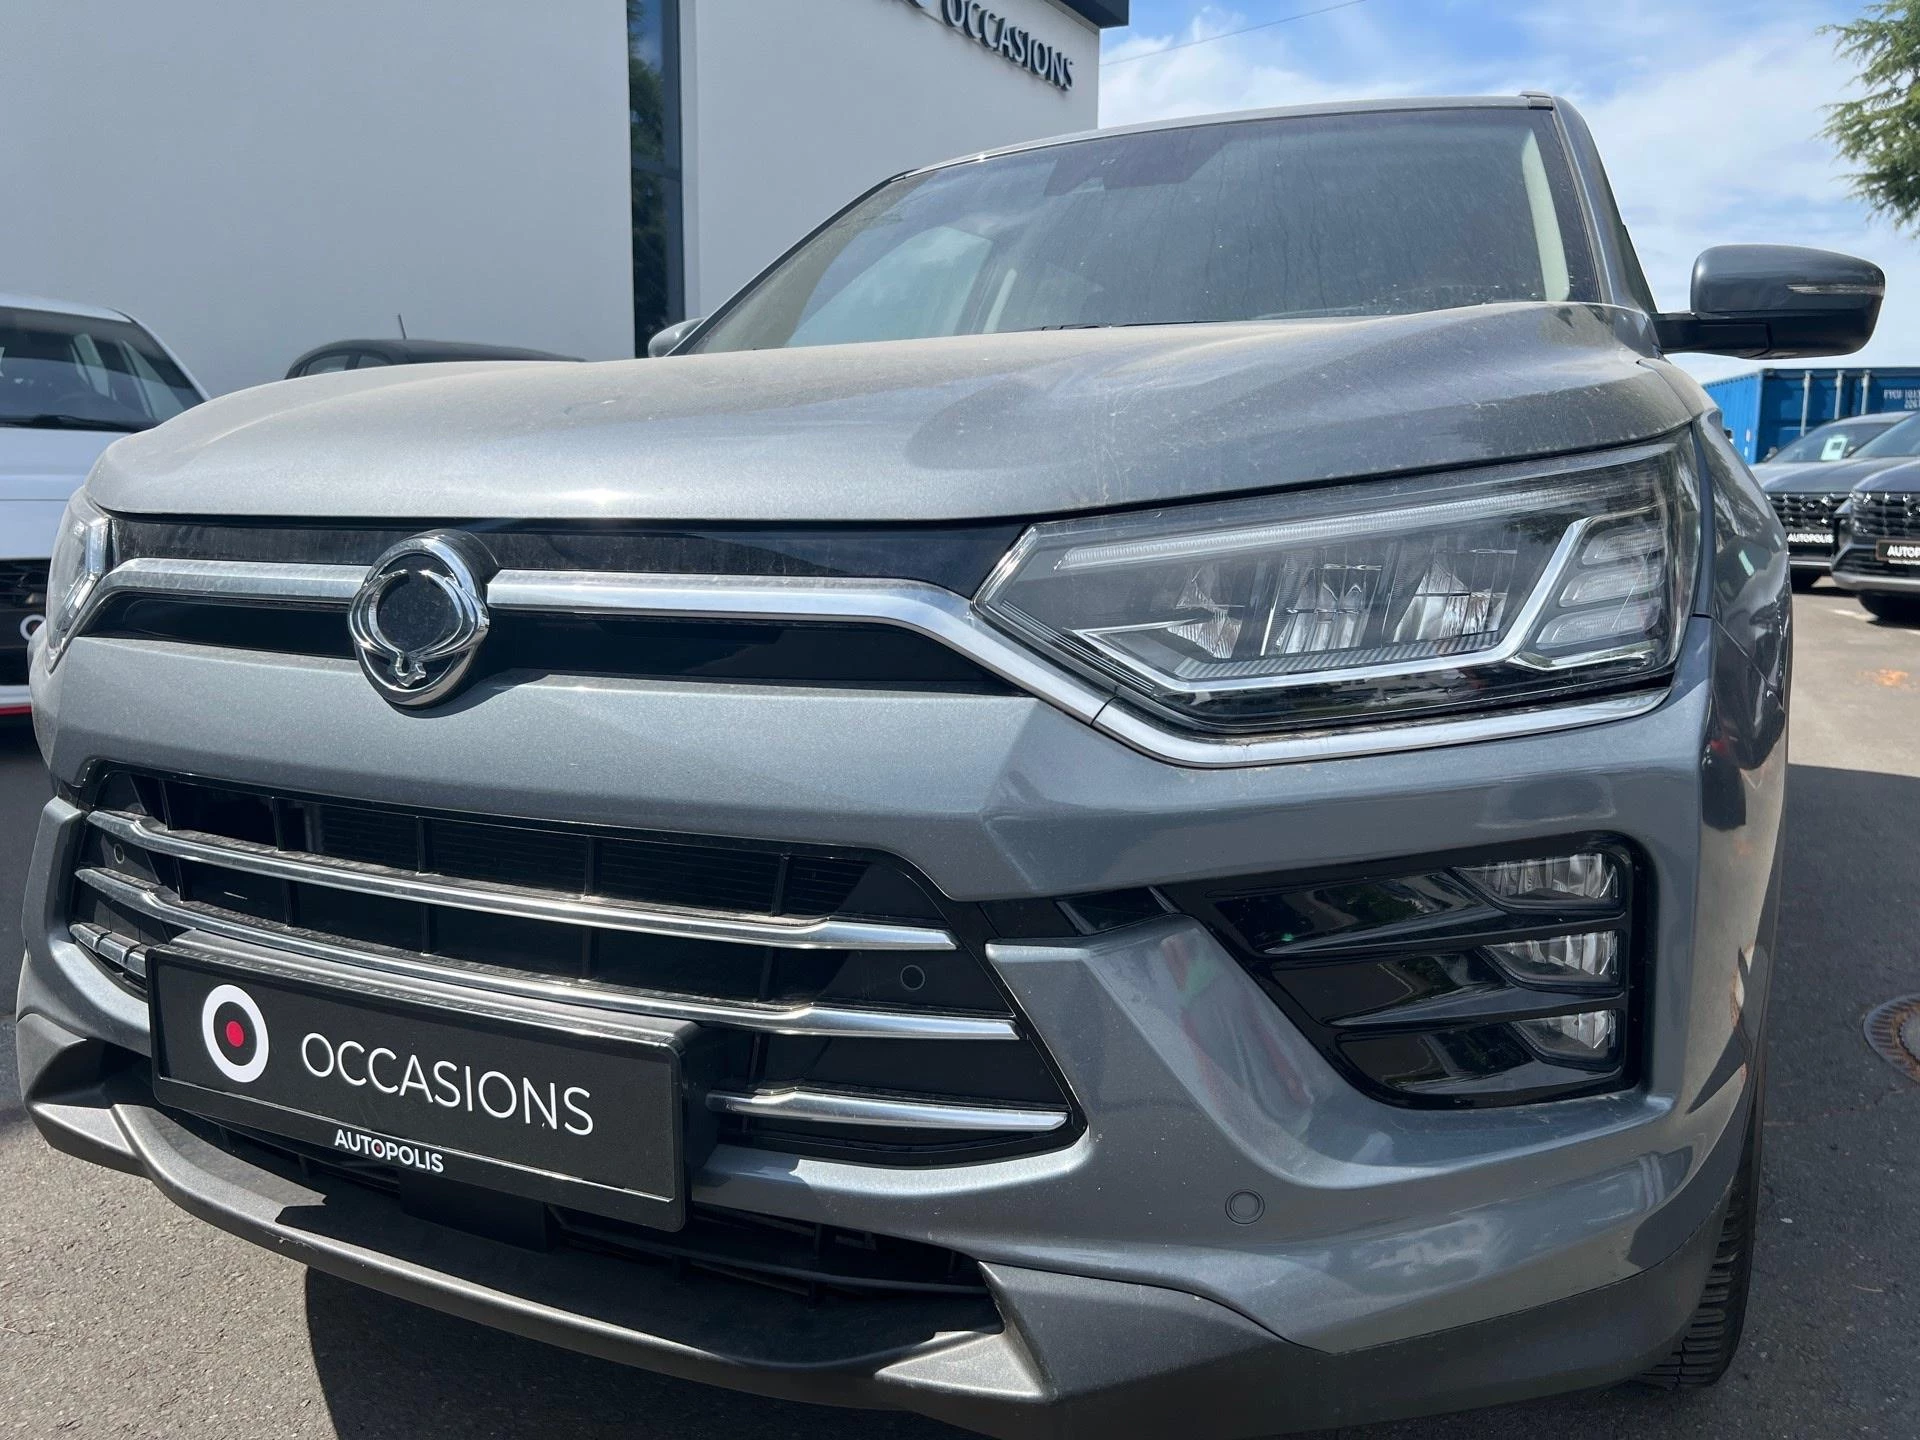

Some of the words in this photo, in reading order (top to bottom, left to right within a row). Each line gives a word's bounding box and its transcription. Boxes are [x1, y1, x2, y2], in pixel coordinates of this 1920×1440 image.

[942, 0, 1073, 91] OCCASIONS
[1787, 533, 1834, 543] AUTOPOLIS
[301, 1032, 594, 1135] OCCASIONS
[334, 1128, 445, 1173] AUTOPOLIS
